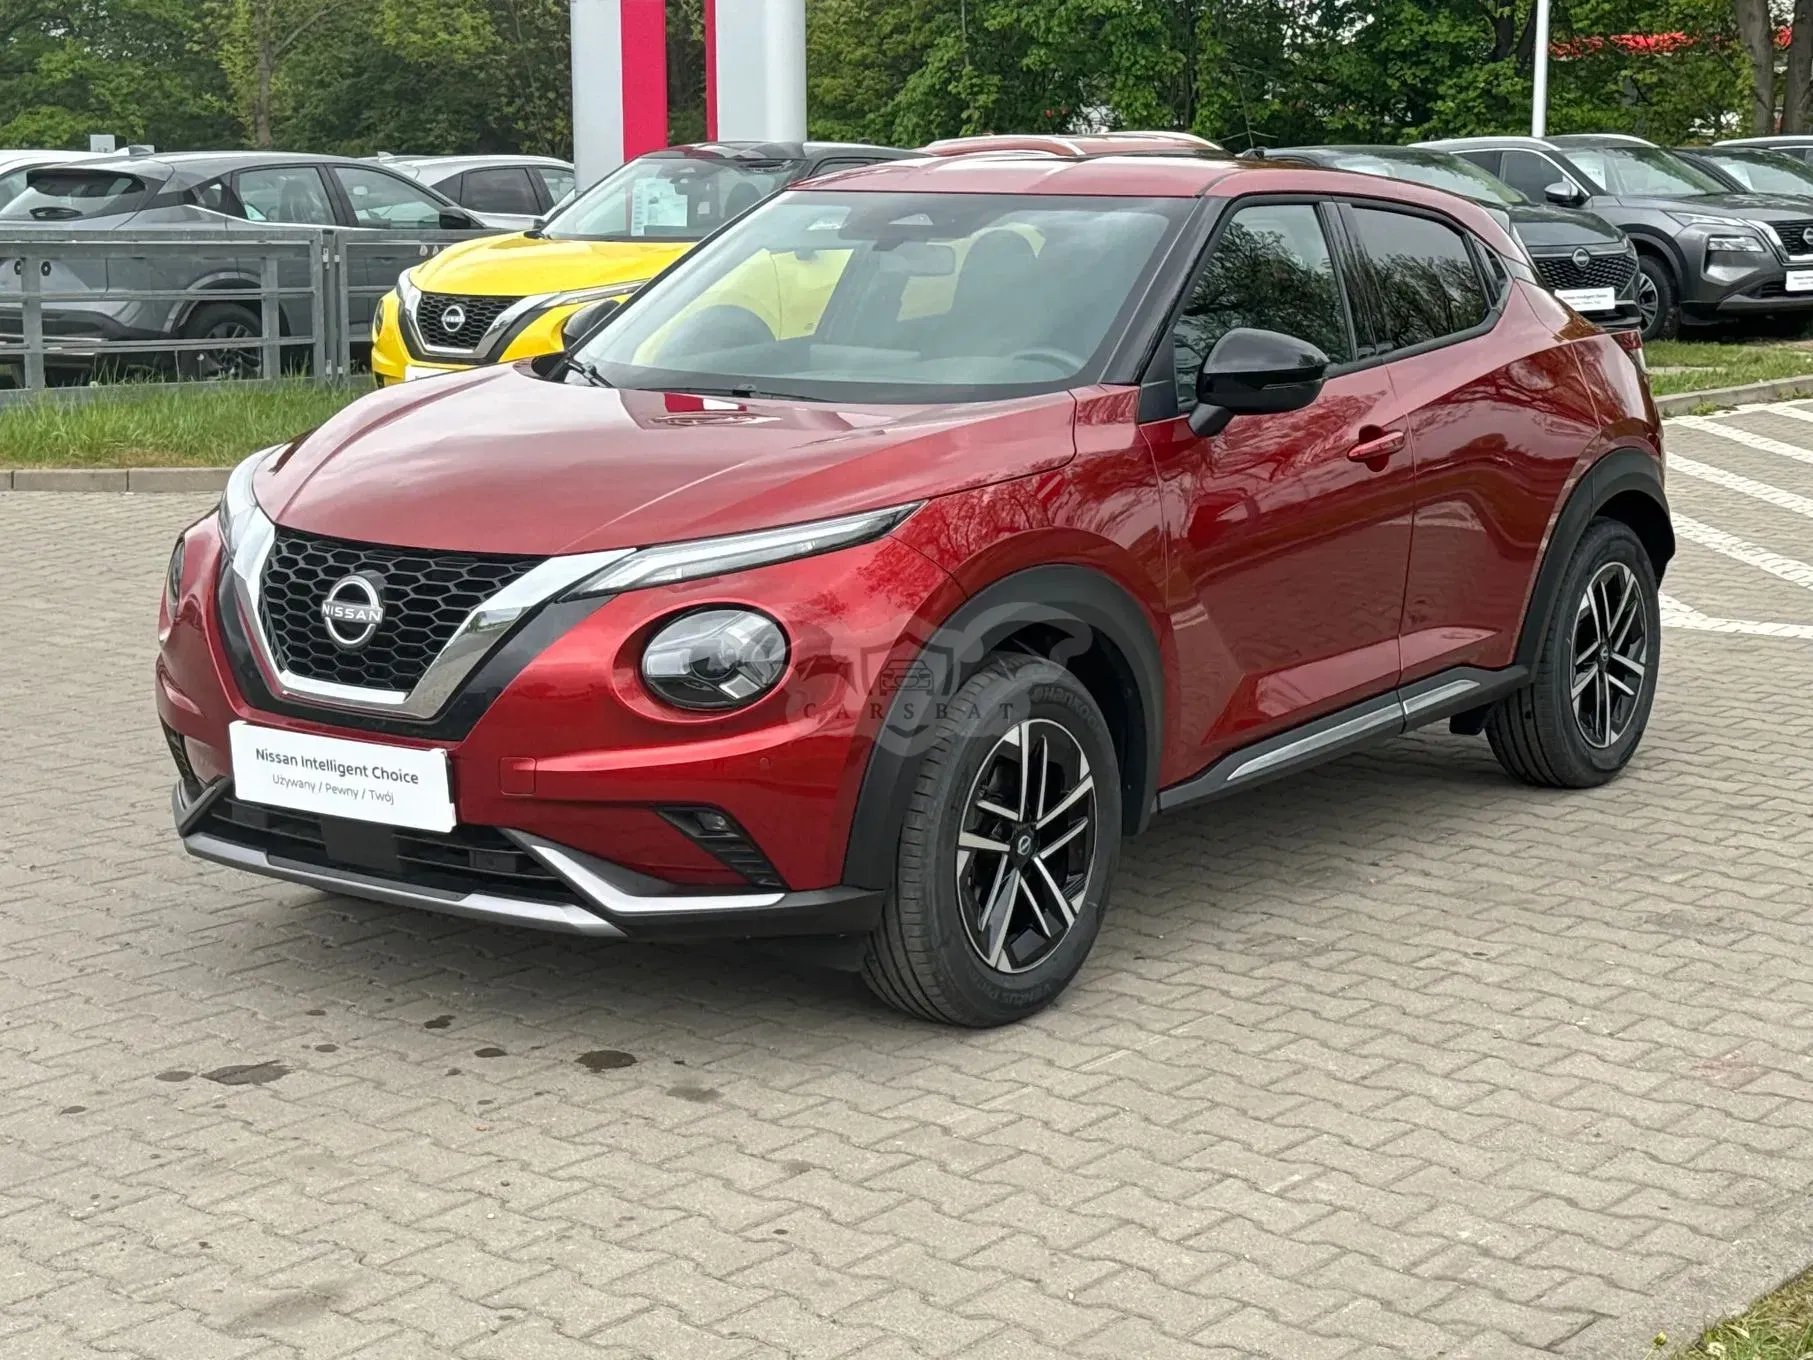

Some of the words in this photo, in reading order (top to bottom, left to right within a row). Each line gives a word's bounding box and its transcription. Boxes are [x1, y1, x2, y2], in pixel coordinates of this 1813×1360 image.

[321, 602, 382, 622] NISSAN
[255, 748, 298, 767] Nissan
[301, 755, 369, 778] Intelligent
[371, 766, 419, 785] Choice
[272, 774, 316, 794] Używany
[325, 784, 359, 800] Pewny
[370, 789, 395, 806] Twój
